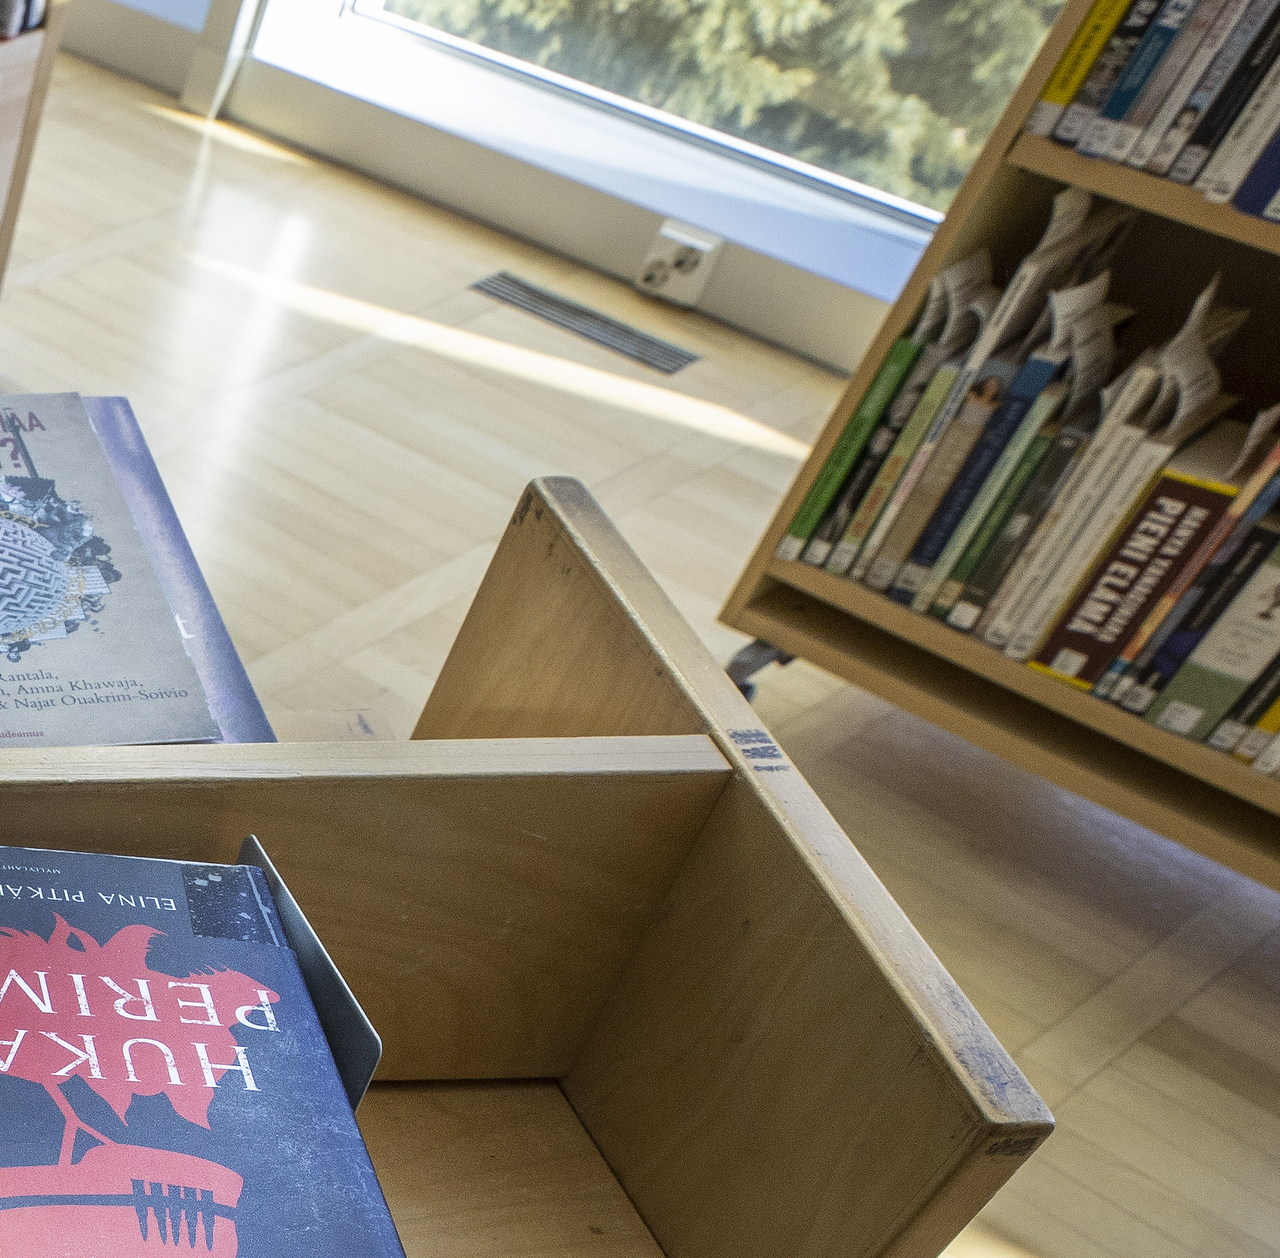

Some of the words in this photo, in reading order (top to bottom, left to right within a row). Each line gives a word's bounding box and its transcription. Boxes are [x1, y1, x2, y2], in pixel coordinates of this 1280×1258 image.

[69, 676, 143, 694] Khawaja,
[14, 697, 56, 712] Najat
[98, 890, 177, 911] ELINA
